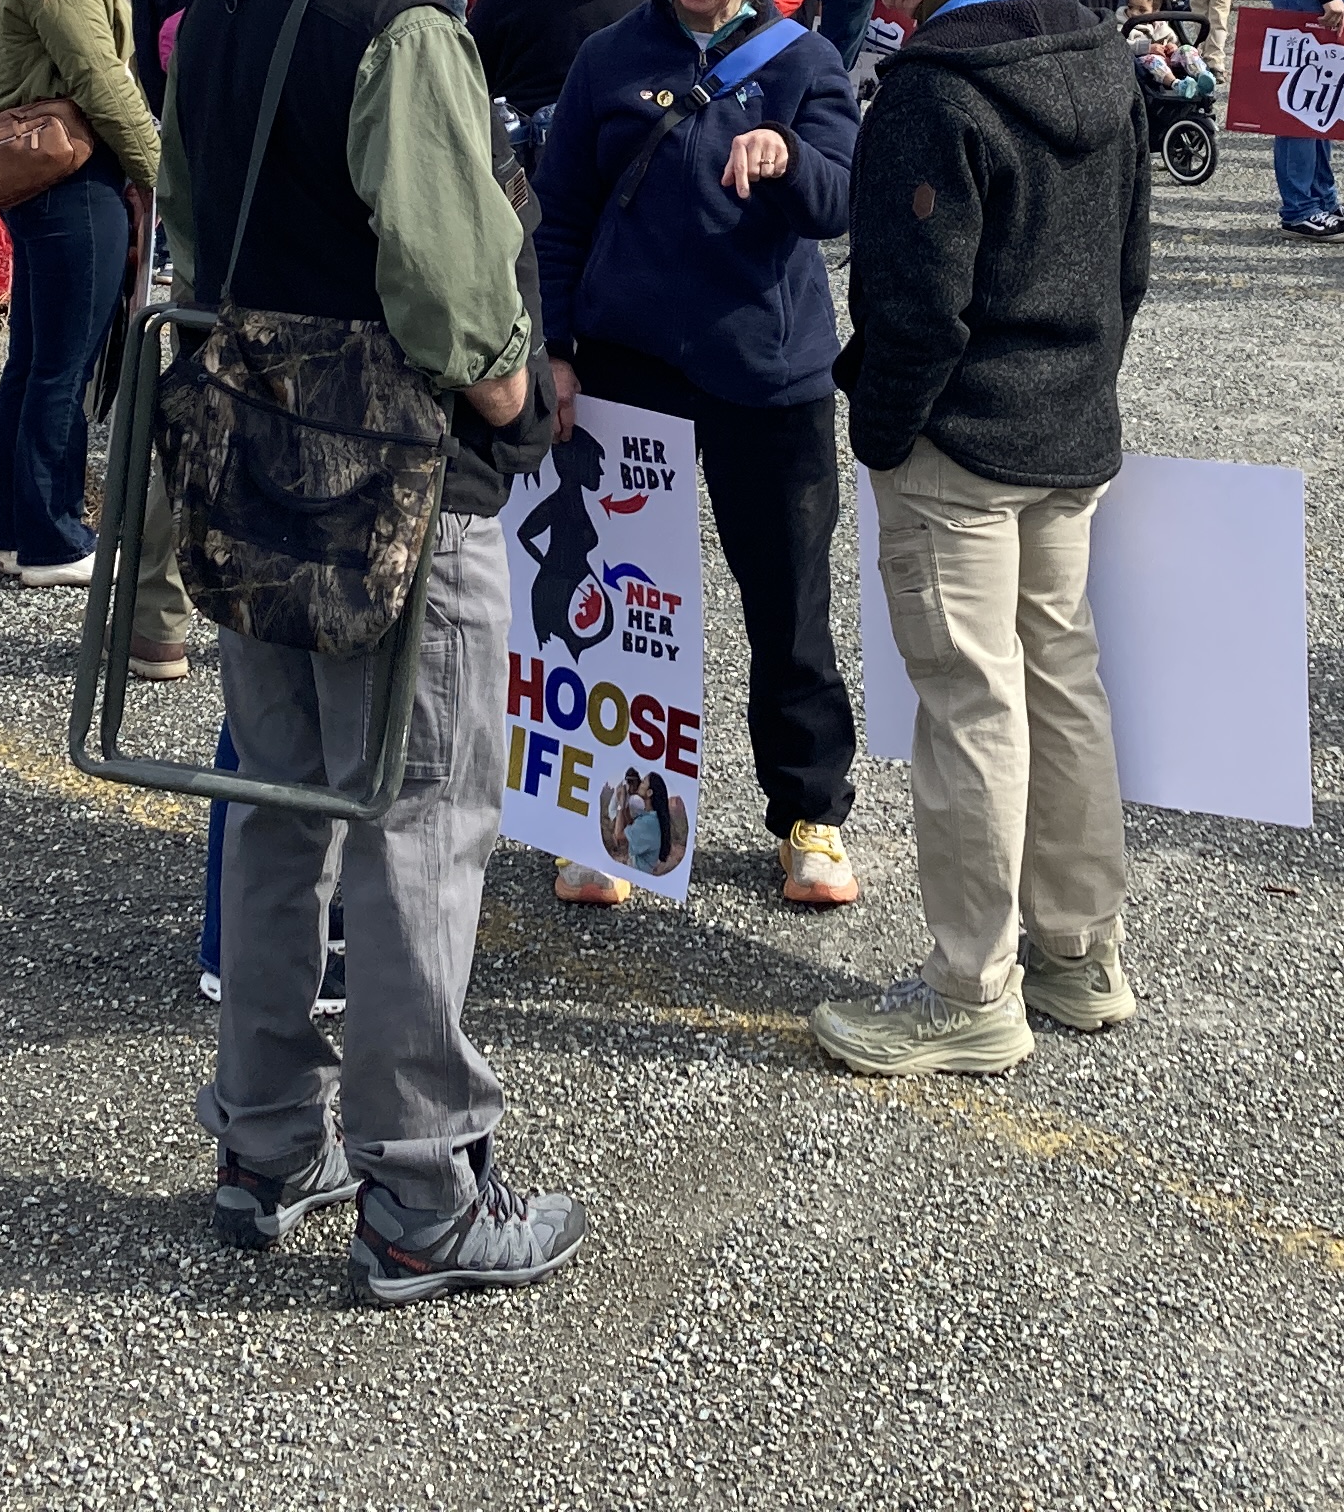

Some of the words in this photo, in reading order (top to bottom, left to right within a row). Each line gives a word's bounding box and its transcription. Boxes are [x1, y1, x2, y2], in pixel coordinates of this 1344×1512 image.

[1267, 34, 1320, 69] Life
[1324, 49, 1337, 59] IS
[621, 435, 667, 465] HER
[620, 462, 676, 492] BODY
[625, 582, 682, 614] NOT
[627, 609, 674, 638] HER
[621, 633, 681, 662] BODY
[507, 652, 701, 779] HOOSE
[506, 728, 594, 817] IFE
